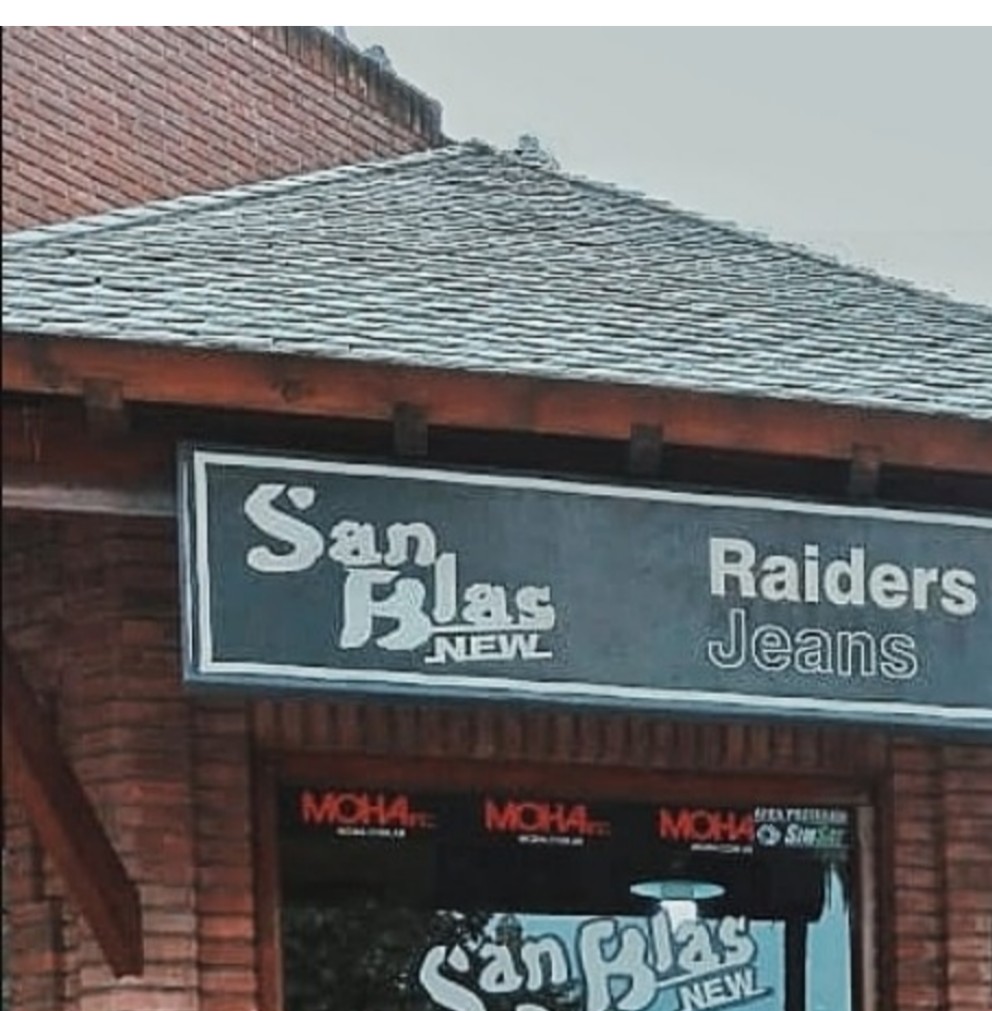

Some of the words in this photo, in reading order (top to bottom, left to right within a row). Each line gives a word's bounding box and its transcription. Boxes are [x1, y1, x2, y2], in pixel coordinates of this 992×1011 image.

[244, 483, 437, 573] San
[340, 552, 556, 650] Blas
[709, 537, 978, 615] Raiders
[425, 633, 553, 663] NEW
[708, 608, 918, 679] Jeans
[301, 790, 408, 826] MOHA
[484, 798, 588, 834] MOHA
[660, 807, 754, 843] MOHA
